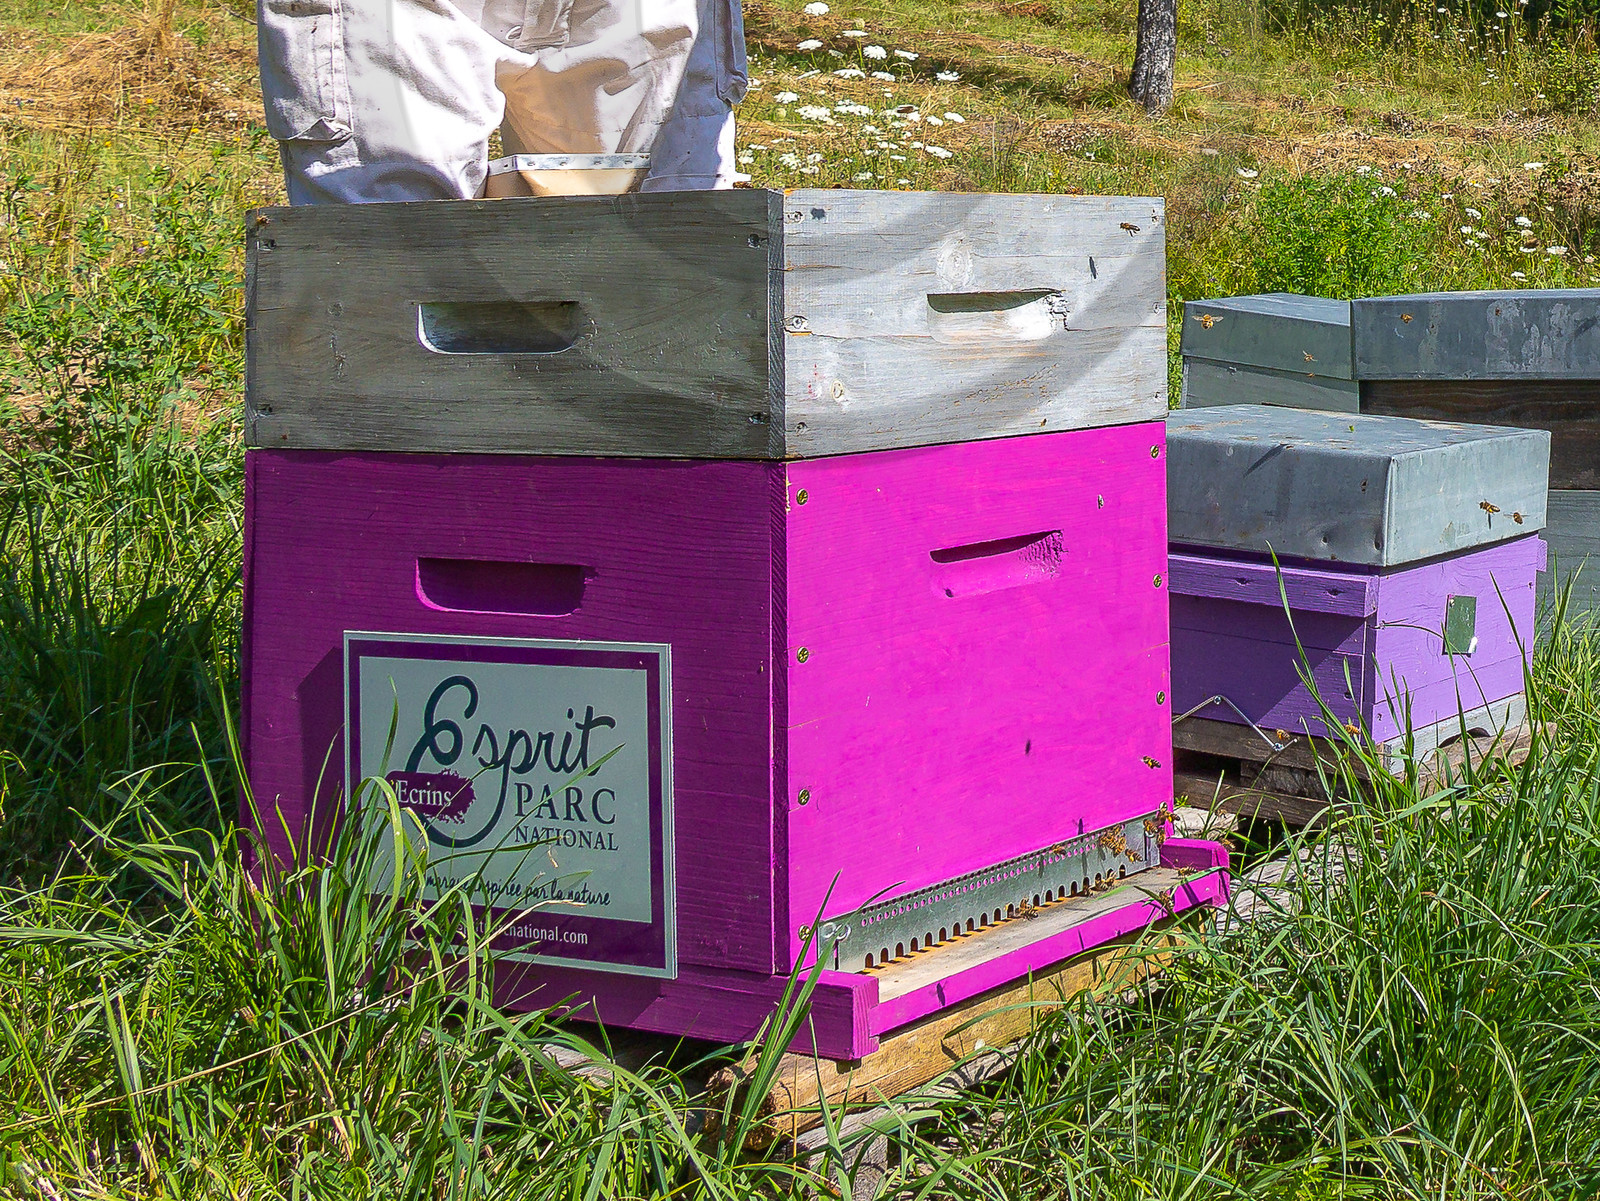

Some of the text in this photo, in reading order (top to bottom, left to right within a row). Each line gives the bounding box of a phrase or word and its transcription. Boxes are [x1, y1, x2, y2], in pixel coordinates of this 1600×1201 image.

[404, 675, 616, 847] Esprit
[514, 782, 616, 825] PARC
[514, 825, 619, 851] NATIONAL
[525, 883, 549, 904] par
[549, 878, 565, 901] la
[566, 882, 611, 906] nature
